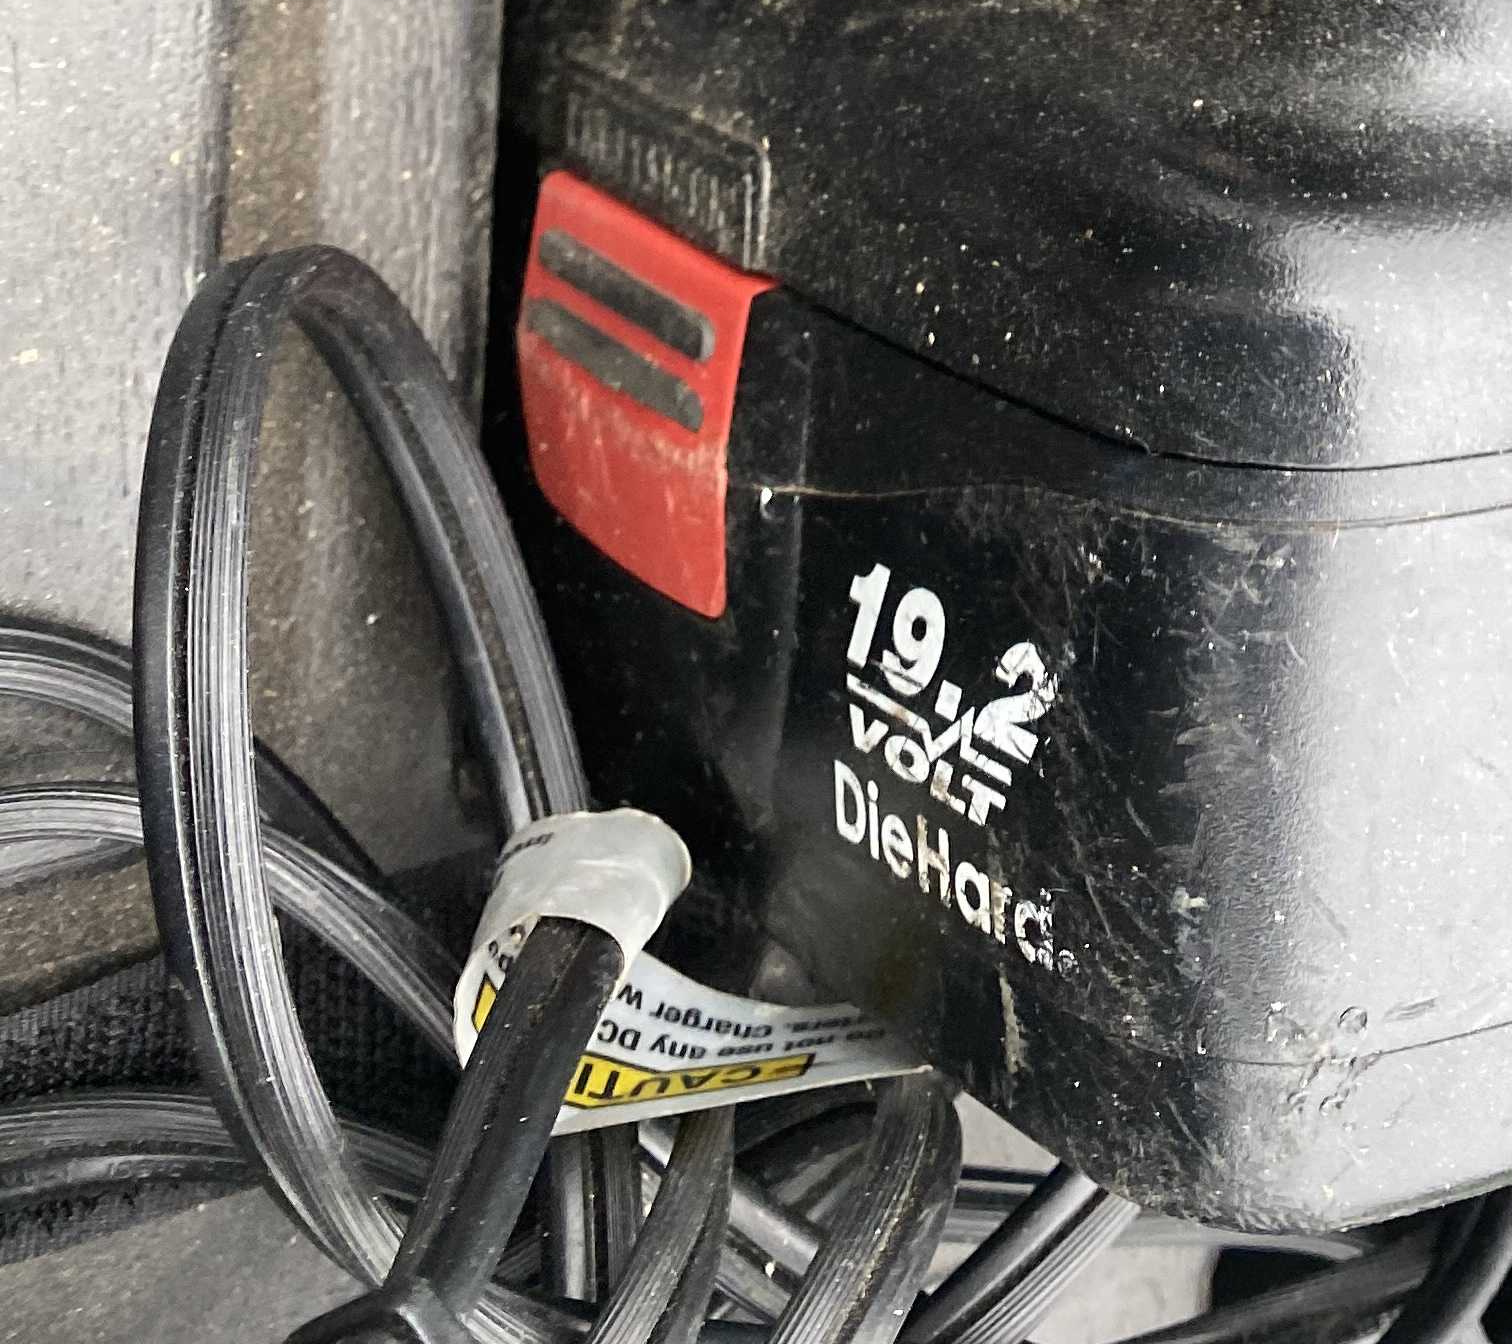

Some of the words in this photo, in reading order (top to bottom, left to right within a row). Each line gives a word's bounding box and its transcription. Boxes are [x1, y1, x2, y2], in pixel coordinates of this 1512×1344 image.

[847, 563, 1060, 765] 19.2
[850, 703, 1008, 826] VOLT
[597, 1018, 642, 1052] DC
[650, 1002, 773, 1039] charger
[650, 1031, 707, 1062] any
[716, 1038, 773, 1059] use
[572, 1061, 764, 1103] CAUTI
